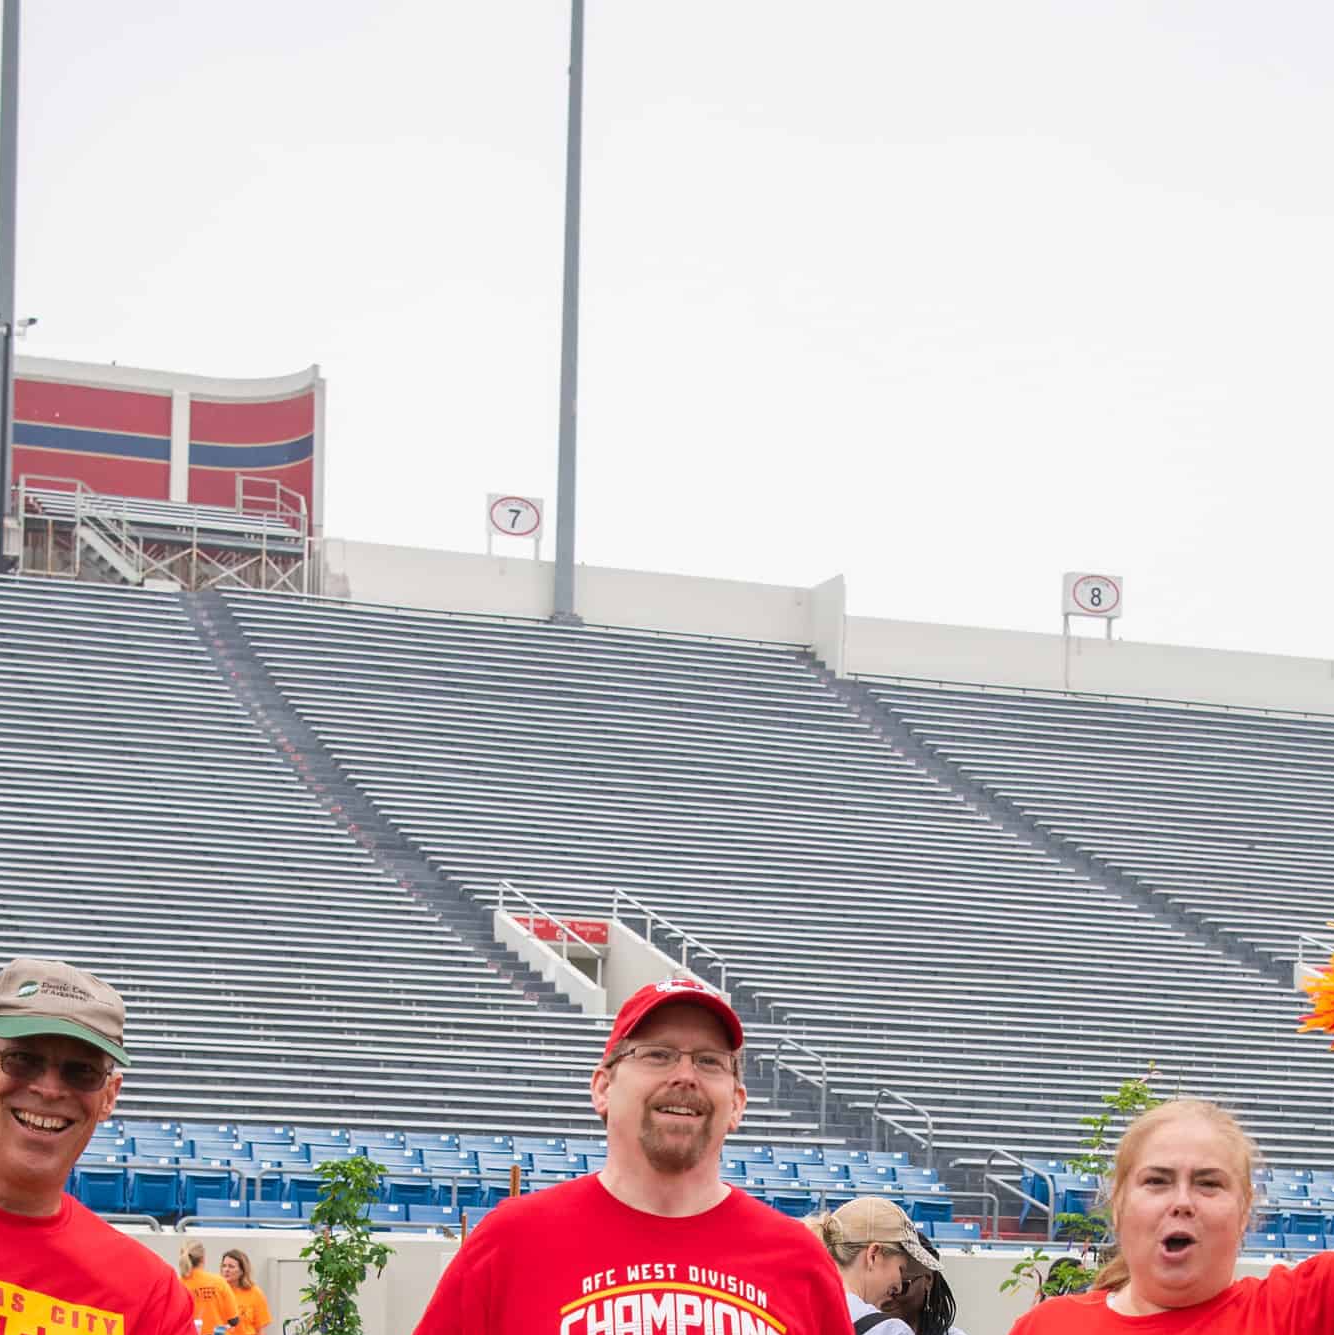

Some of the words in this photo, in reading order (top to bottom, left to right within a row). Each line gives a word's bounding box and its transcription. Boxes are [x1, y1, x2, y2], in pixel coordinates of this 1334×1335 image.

[508, 508, 521, 528] 7
[1090, 587, 1101, 606] 8
[582, 1269, 616, 1293] AFC
[627, 1264, 677, 1281] WEST
[689, 1265, 768, 1308] DIVISION
[51, 1305, 118, 1335] CITY
